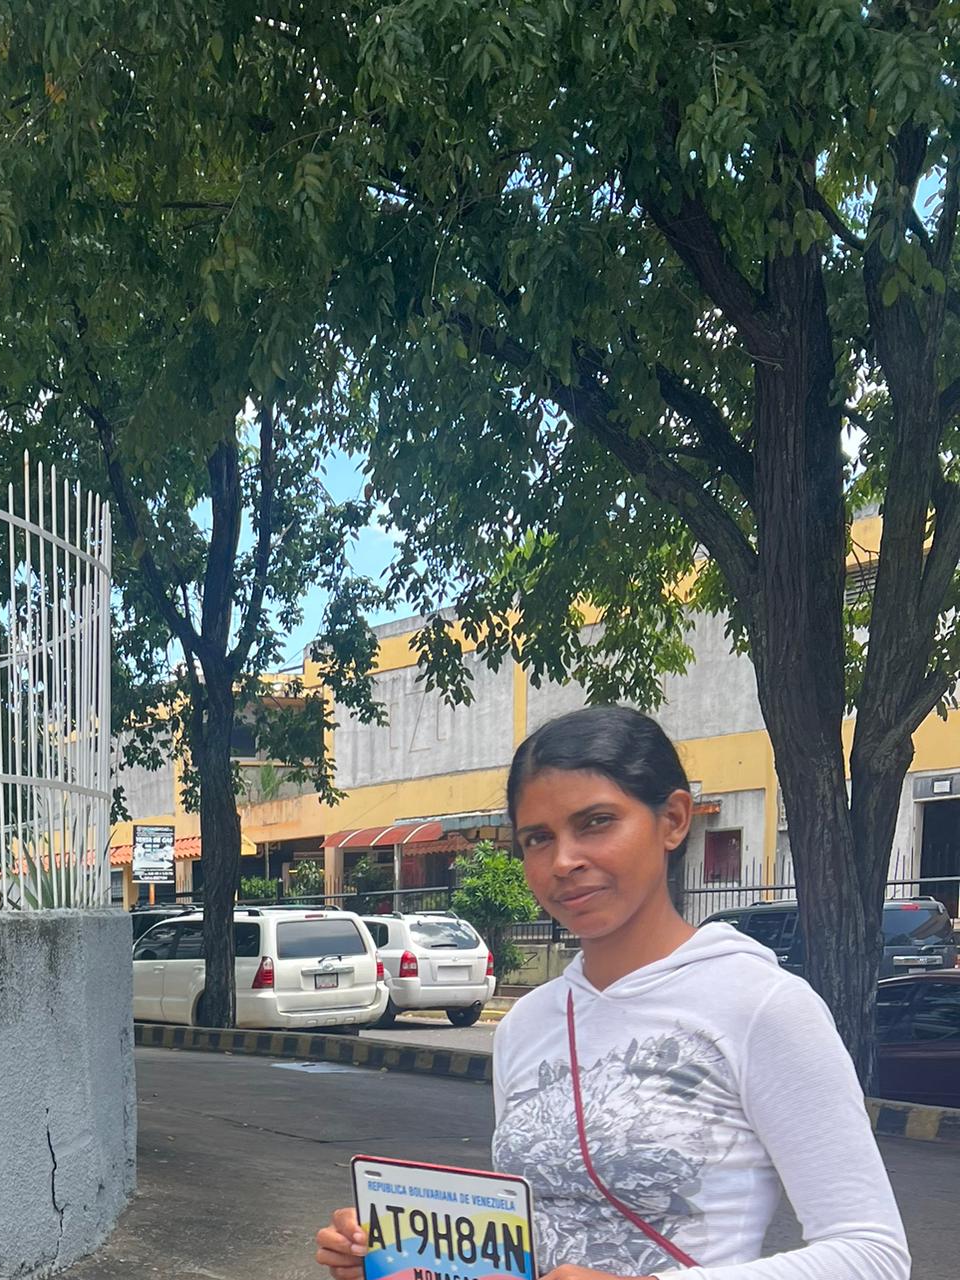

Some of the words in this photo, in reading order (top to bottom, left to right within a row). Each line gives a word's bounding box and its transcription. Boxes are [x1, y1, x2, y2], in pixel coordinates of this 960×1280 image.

[367, 1180, 407, 1196] REPUBLICA
[409, 1185, 458, 1202] BOLIVARIANA
[460, 1193, 470, 1205] DE
[472, 1195, 516, 1211] VENEZUELA
[368, 1203, 526, 1274] AT9H84N
